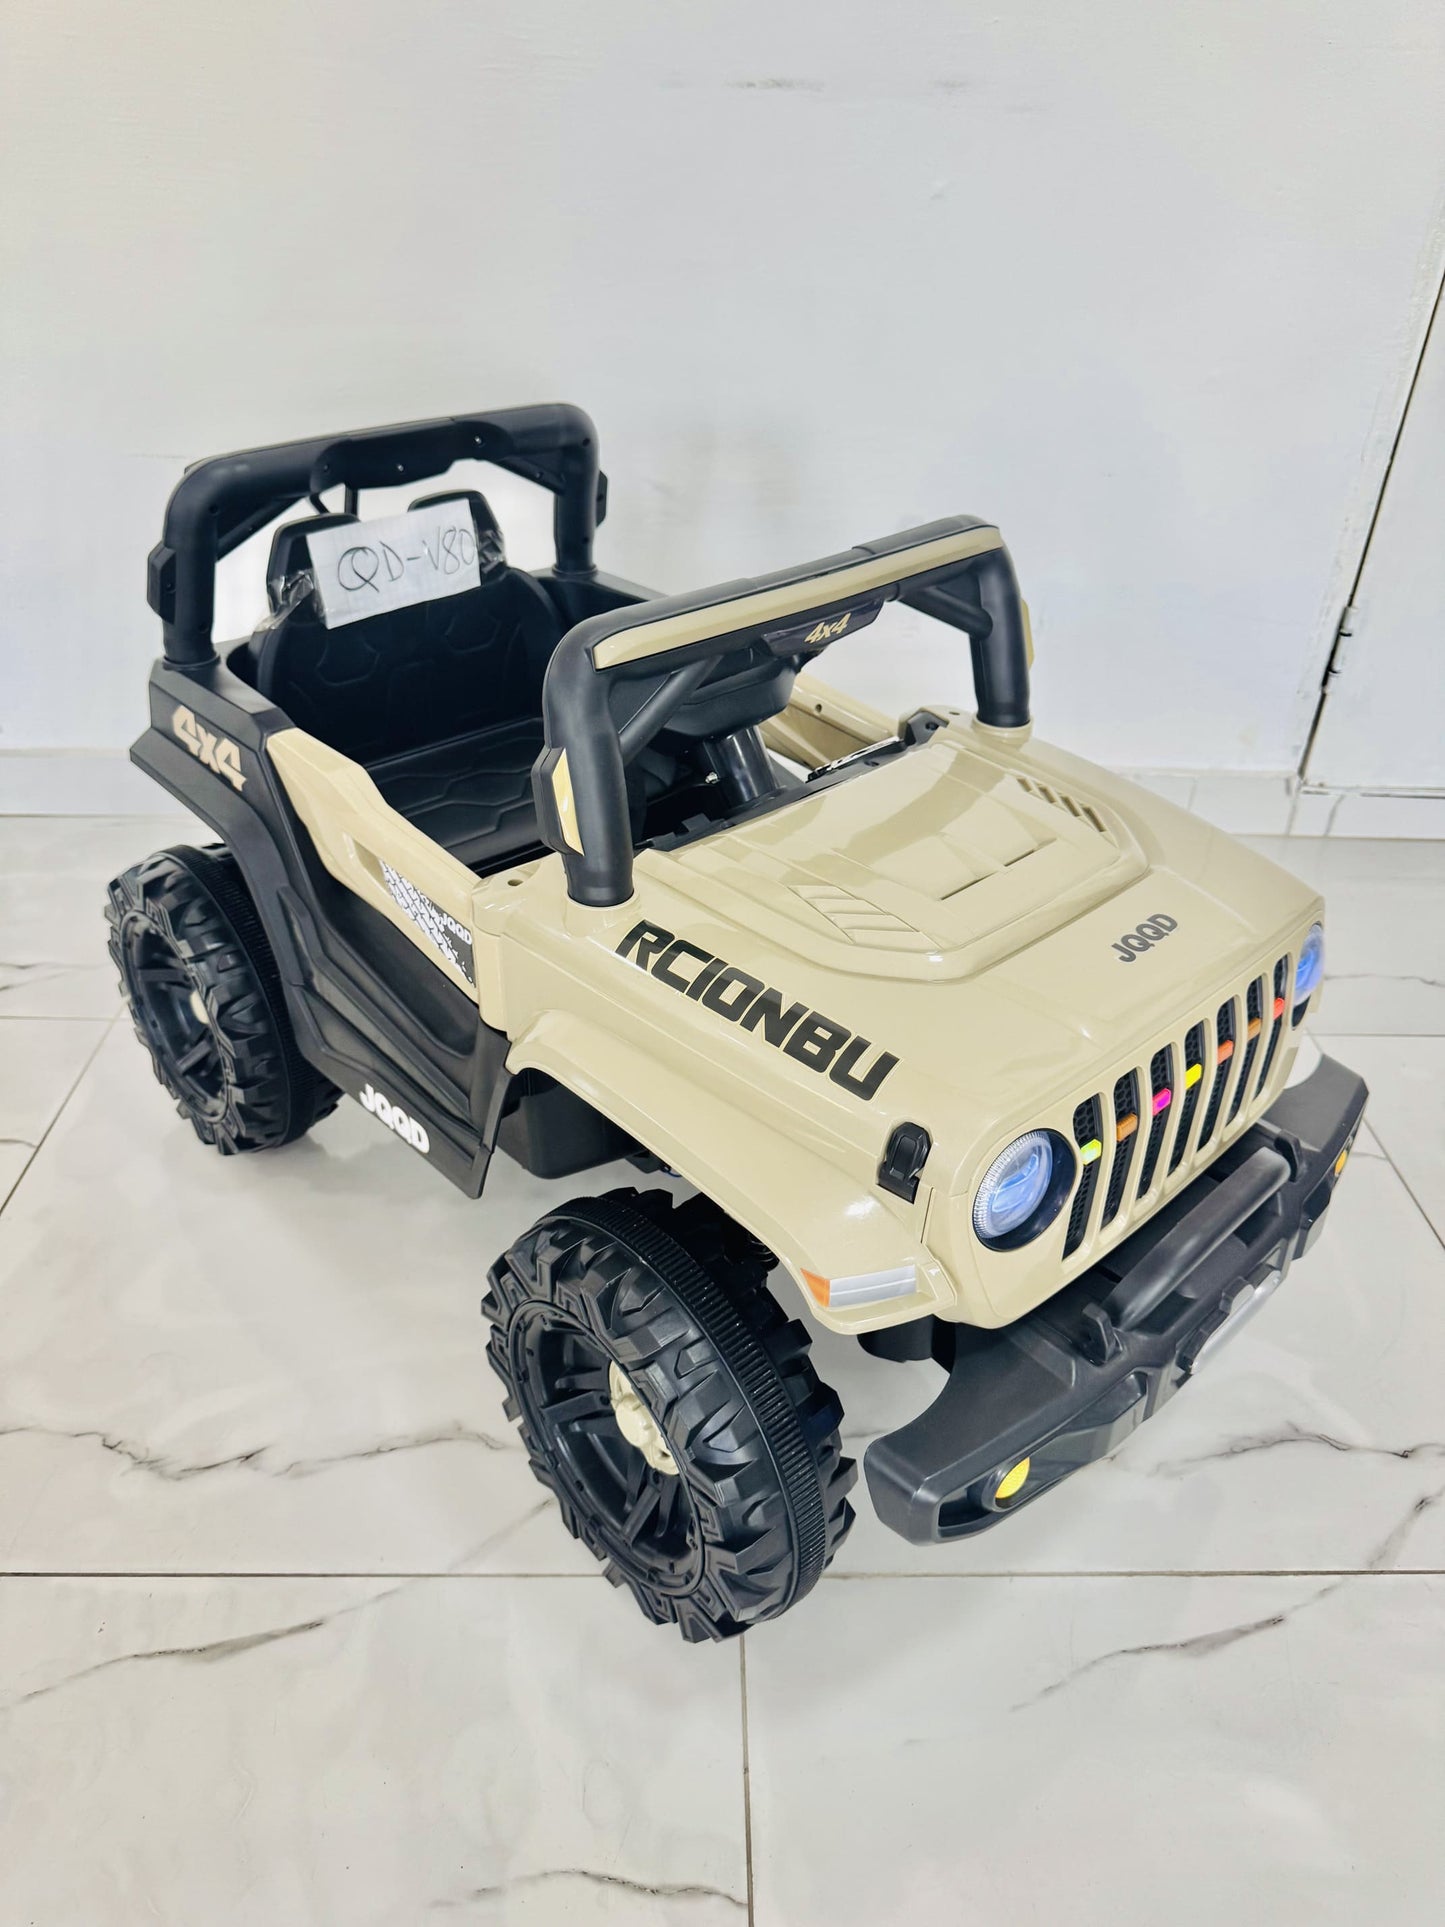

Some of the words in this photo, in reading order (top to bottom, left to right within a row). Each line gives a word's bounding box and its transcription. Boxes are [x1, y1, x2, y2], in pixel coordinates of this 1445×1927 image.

[337, 526, 477, 593] QD-V80
[1111, 913, 1178, 963] JQQD
[614, 919, 900, 1101] RCIONBU
[359, 1083, 430, 1154] JQQD
